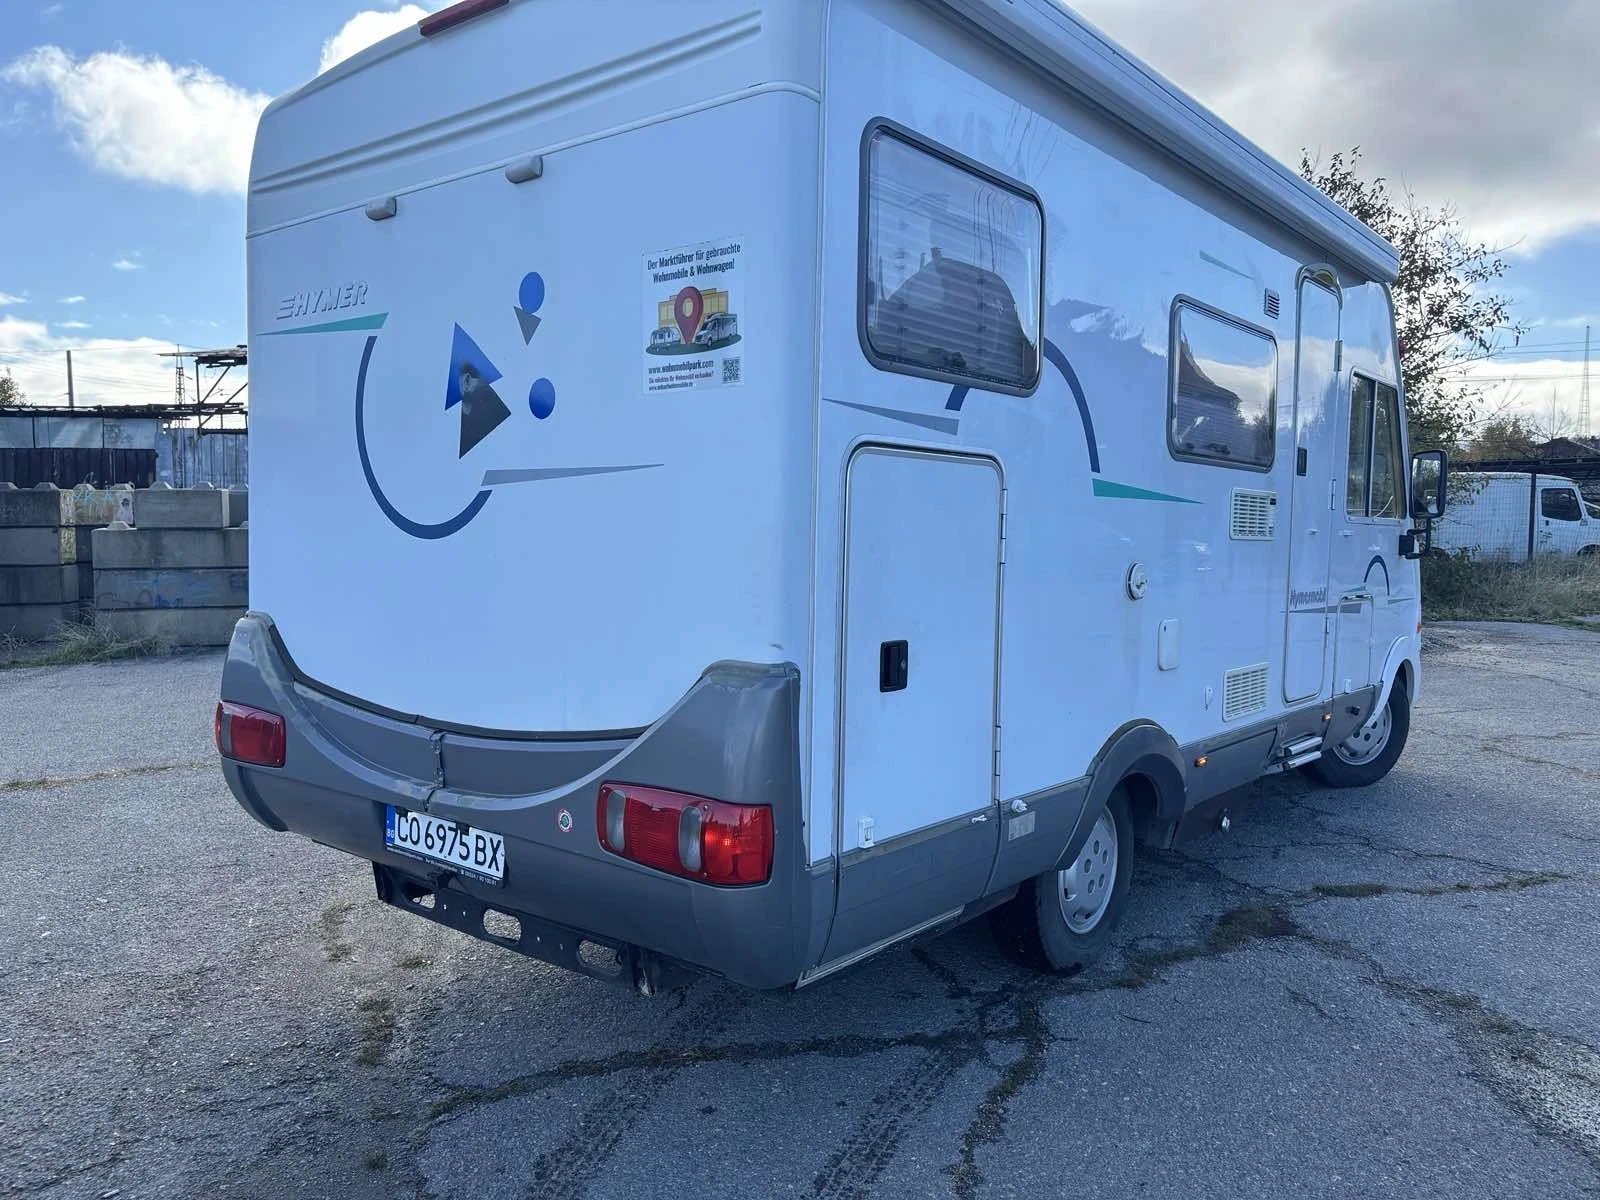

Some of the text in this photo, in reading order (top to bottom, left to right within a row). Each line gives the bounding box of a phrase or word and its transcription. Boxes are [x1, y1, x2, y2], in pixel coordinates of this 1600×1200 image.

[647, 243, 741, 271] Der Marktführer für gebrauchte
[652, 258, 735, 284] Wohnmobile & Wohnwagen!
[276, 284, 369, 320] HYMER
